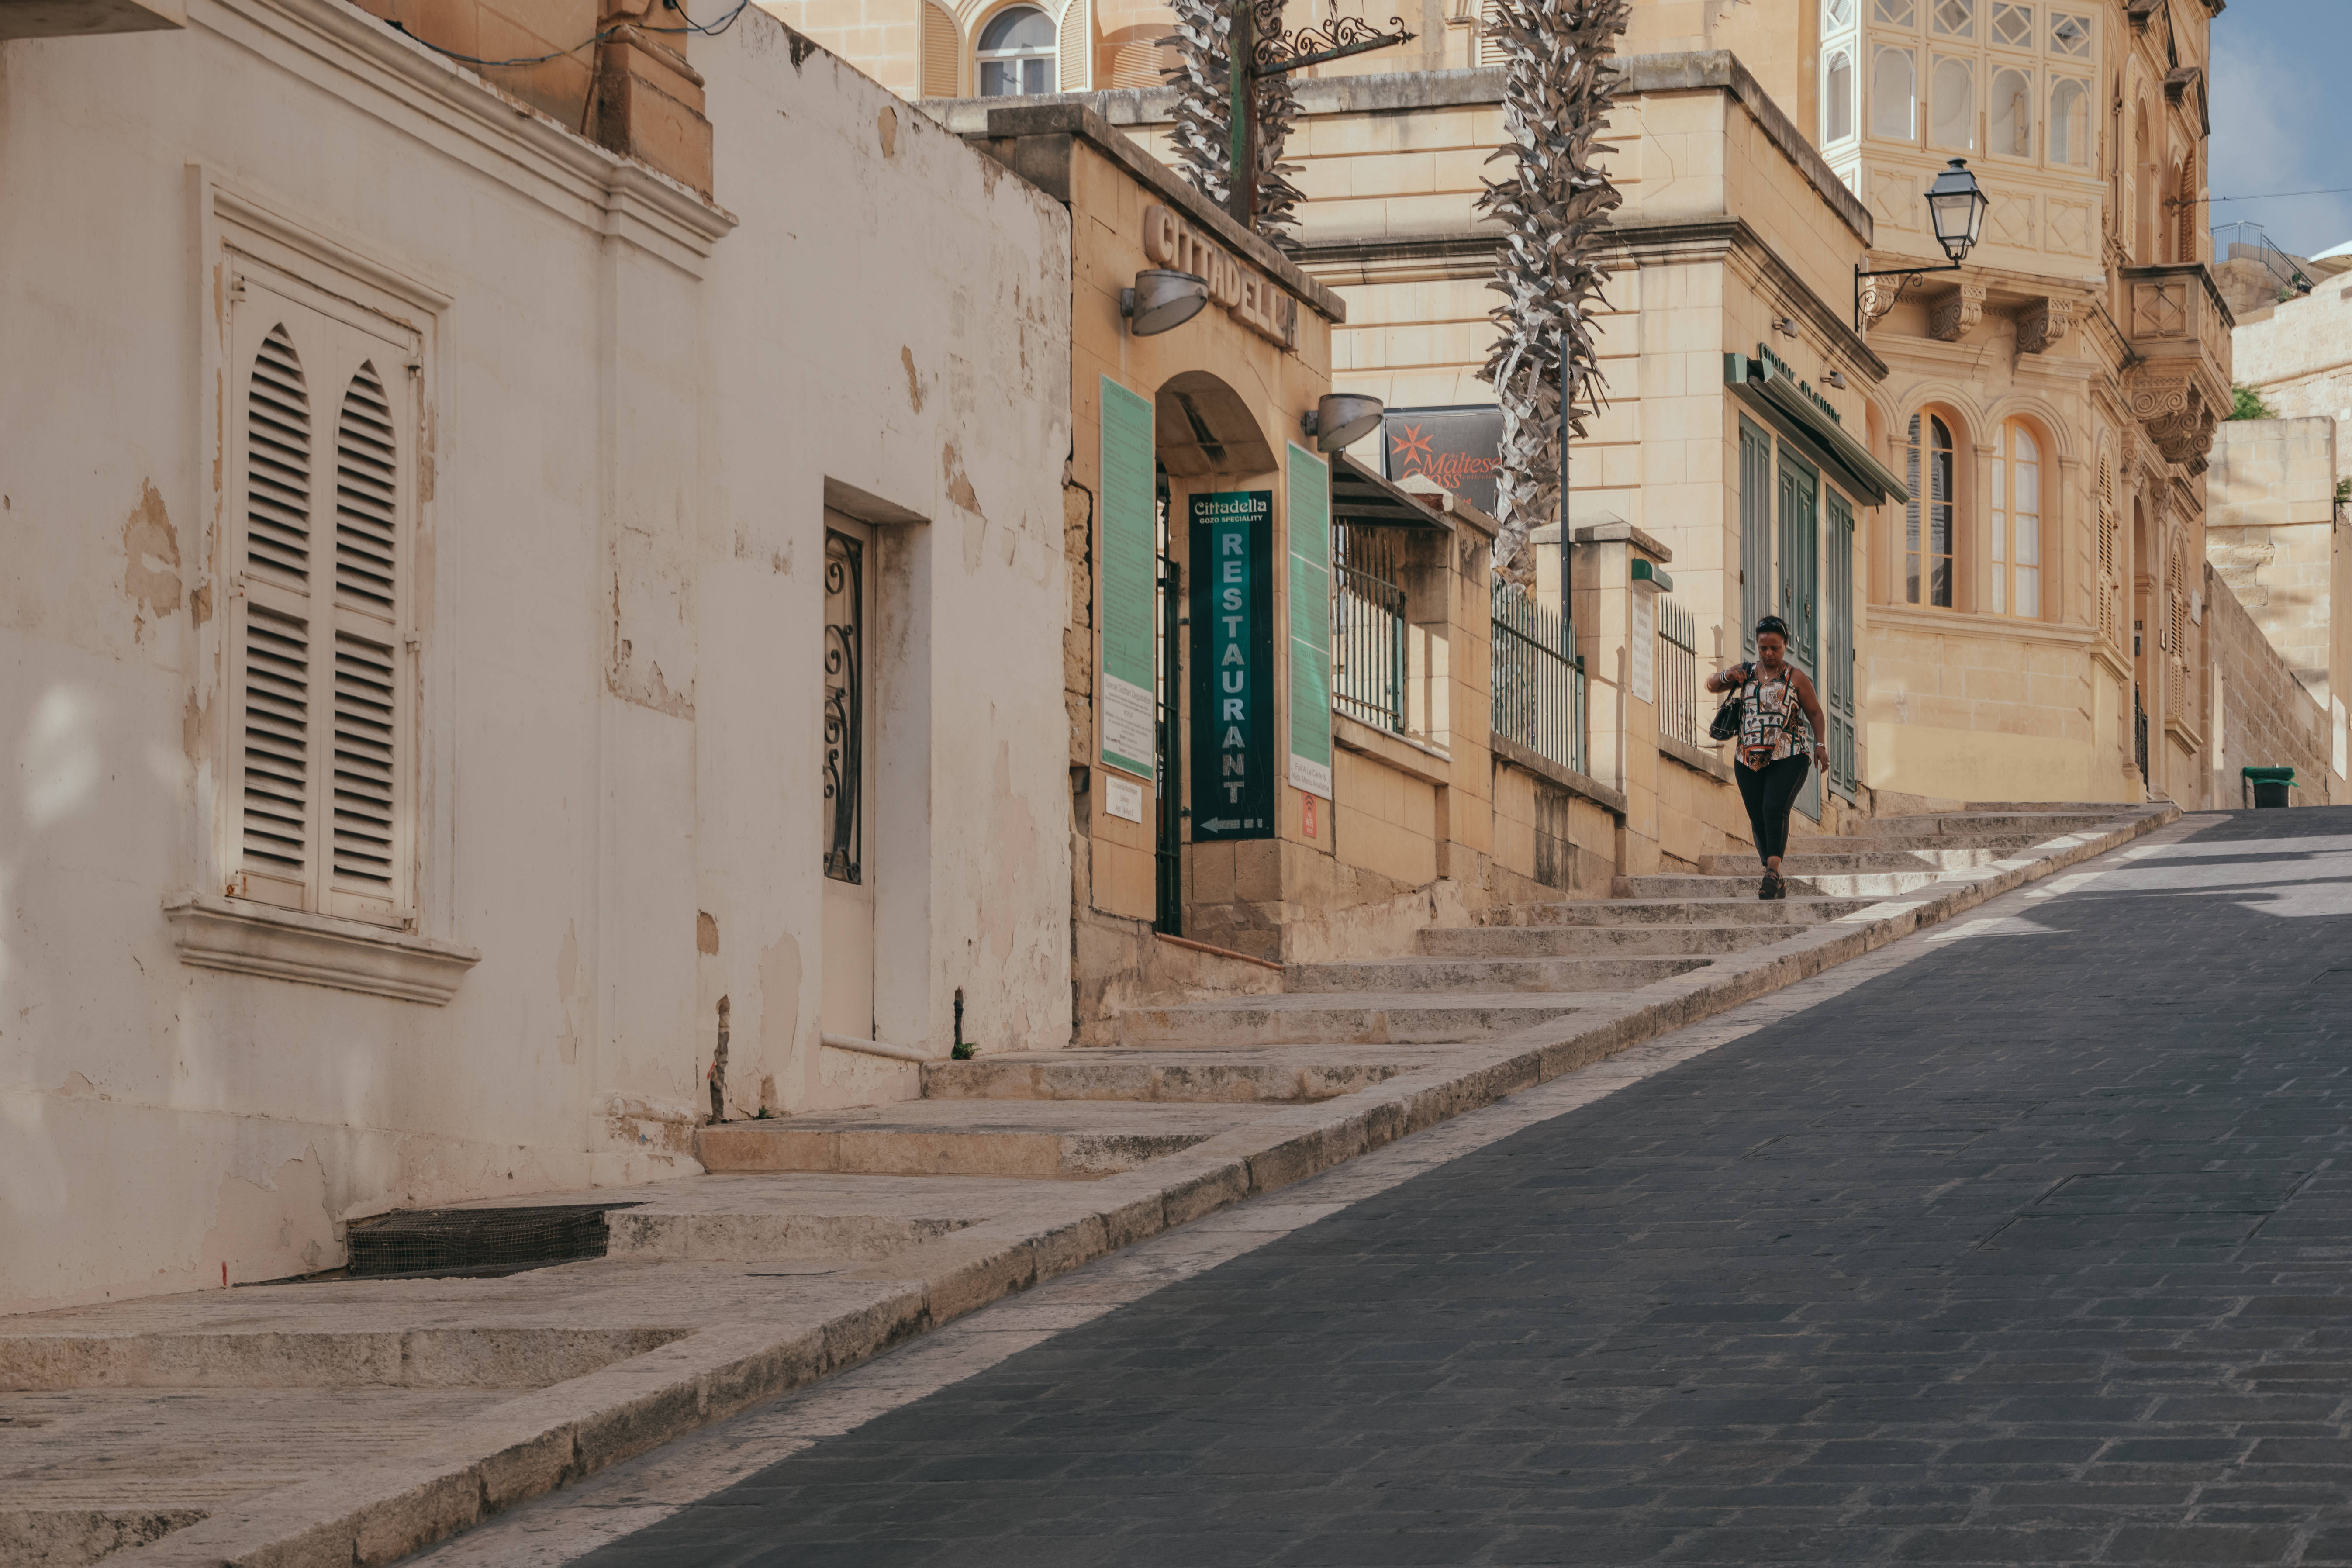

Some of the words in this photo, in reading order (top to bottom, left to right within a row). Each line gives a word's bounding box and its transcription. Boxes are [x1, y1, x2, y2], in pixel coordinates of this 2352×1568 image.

[1145, 205, 1299, 352] CITTADELLA
[1423, 452, 1501, 475] Maltese
[1195, 498, 1267, 515] Cittadella
[1221, 533, 1245, 804] RESTAURANT
[1292, 772, 1301, 782] Kids
[1302, 775, 1312, 786] Menu
[1313, 780, 1329, 792] Available
[1306, 767, 1312, 776] La
[1312, 769, 1323, 780] Carte
[1120, 794, 1129, 805] Living
